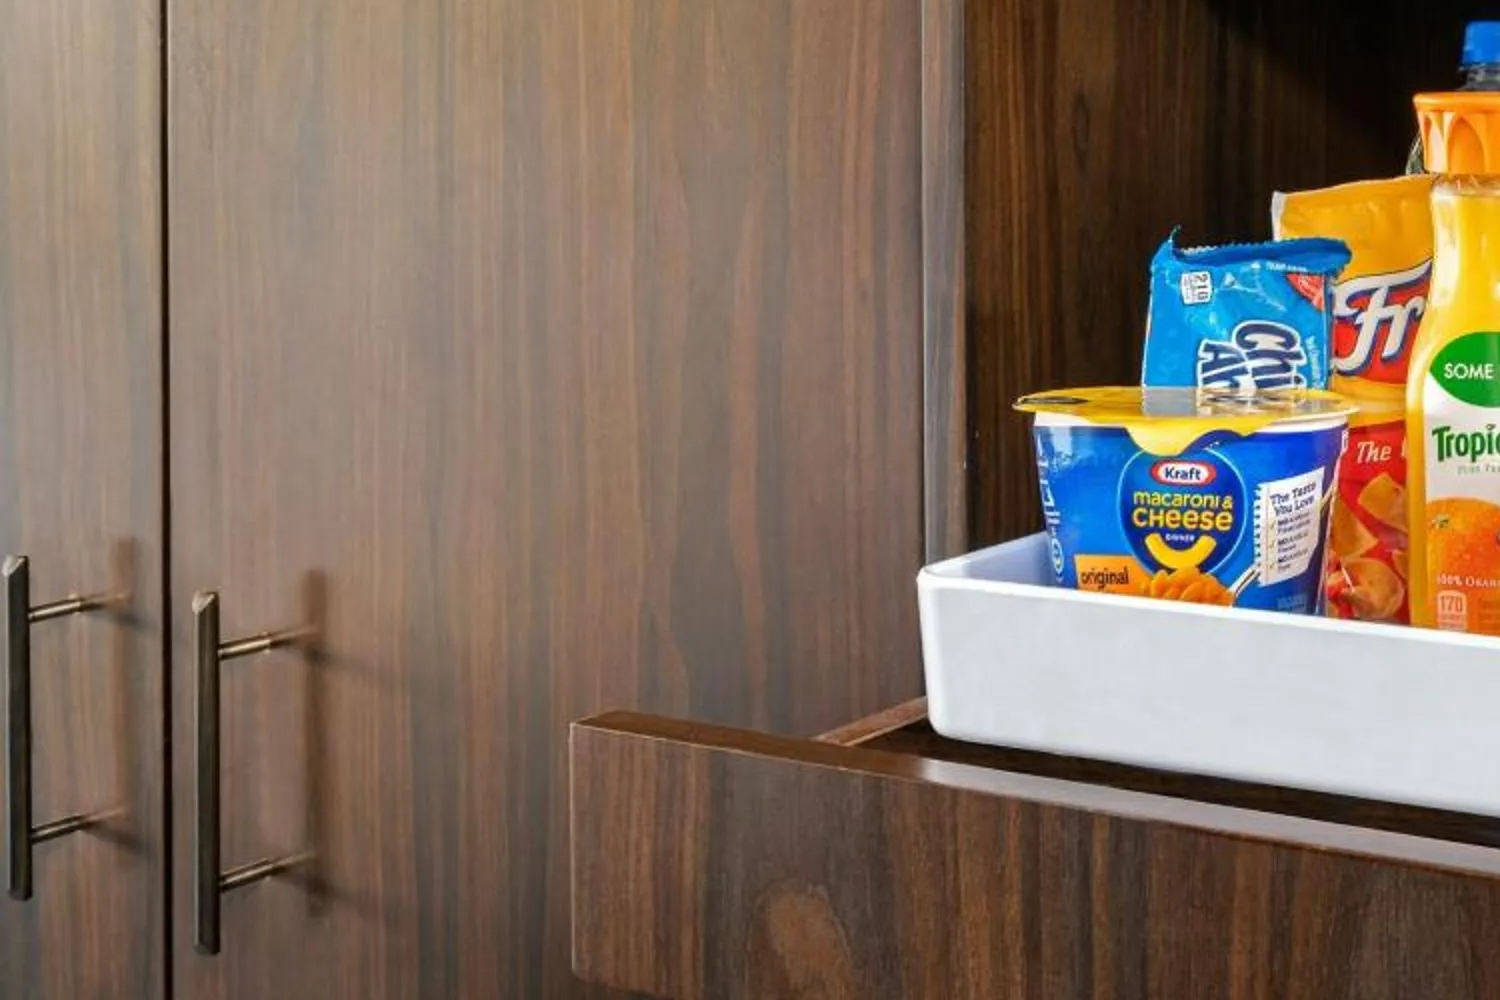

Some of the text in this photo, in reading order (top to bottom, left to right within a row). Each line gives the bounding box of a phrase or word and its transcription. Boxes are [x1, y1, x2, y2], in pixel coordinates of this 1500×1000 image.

[1329, 257, 1433, 373] Fr
[1233, 321, 1307, 388] Chi
[1443, 363, 1494, 379] SOME
[1356, 440, 1392, 463] The
[1164, 466, 1202, 481] Kraft
[1133, 491, 1234, 509] macaroni &
[1270, 493, 1290, 505] The
[1274, 505, 1293, 517] You
[1081, 566, 1130, 591] original
[1440, 596, 1463, 613] 170
